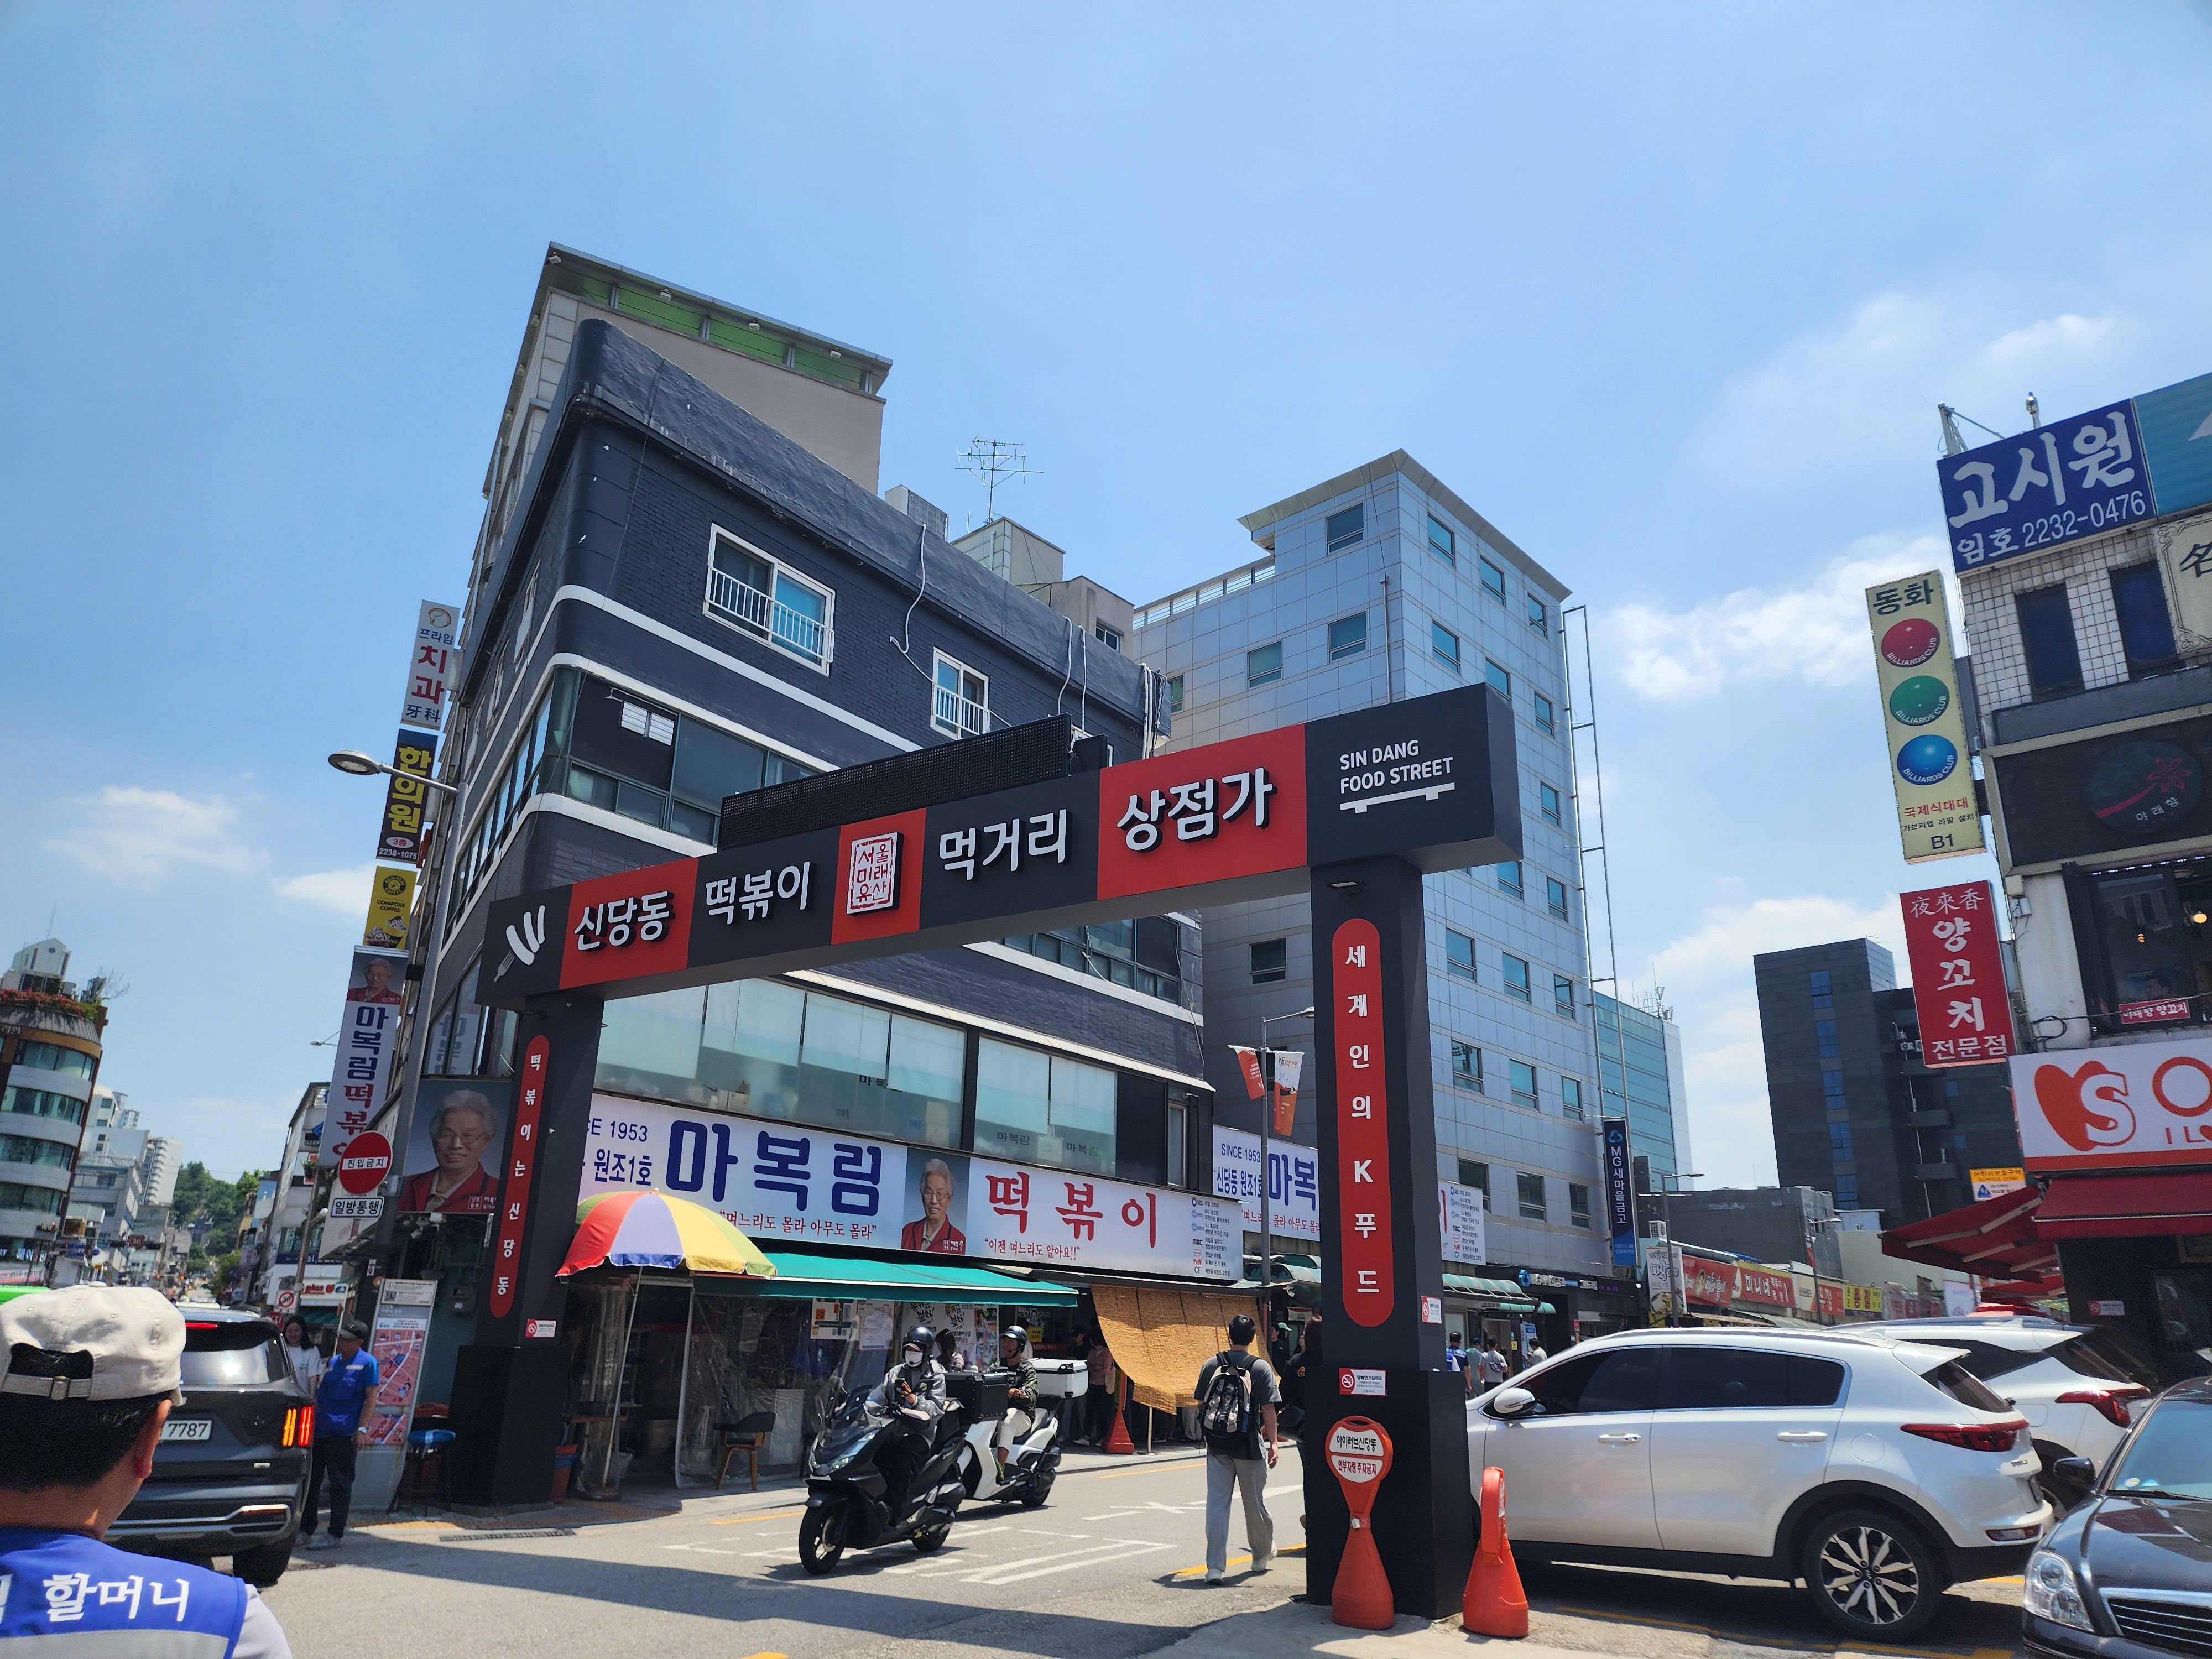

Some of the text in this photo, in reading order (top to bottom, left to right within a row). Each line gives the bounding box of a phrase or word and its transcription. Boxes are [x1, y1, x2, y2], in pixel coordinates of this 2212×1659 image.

[1949, 411, 2135, 528] 고시원
[2022, 490, 2146, 547] 2232-0476
[1873, 579, 1935, 615] 동화
[419, 628, 453, 645] 프라임
[1886, 637, 1937, 666] BILLIARDS CLUB
[411, 645, 447, 705] 치과
[405, 704, 441, 723] 牙科
[1896, 695, 1947, 724] BILLIARDS CLUB
[1339, 739, 1420, 770] SIN DANG
[1903, 754, 1954, 783] BILLIARDS CLUB
[1340, 756, 1454, 794] FOOD STREET
[388, 746, 432, 834] 한의원
[1904, 797, 1969, 818] 국제식대대
[1958, 813, 1974, 822] 설치
[378, 847, 418, 860] 2238-1075
[858, 843, 889, 864] 서울
[1931, 833, 1954, 849] B1
[574, 766, 1274, 951] 신당동 떡볶이 먹거리 상점가
[857, 865, 888, 883] 미래
[855, 883, 887, 902] 유산
[1910, 888, 1984, 918] 夜來香
[1933, 918, 1985, 1032] 양꼬치
[347, 1005, 389, 1081] 마복림
[1932, 1034, 2007, 1061] 전문점
[610, 1120, 648, 1142] 1953
[1345, 944, 1380, 1294] 세계인의 K푸드
[997, 1131, 1030, 1146] 마복림
[1066, 1142, 1099, 1157] 마복림
[347, 1158, 385, 1168] 진입금지
[1221, 1143, 1261, 1163] SINCE 1953
[497, 1053, 541, 1296] 떡볶이는 신당동
[593, 1149, 653, 1187] 원조1호
[665, 1119, 882, 1217] 마복림
[1217, 1166, 1238, 1196] 신당동
[1611, 1146, 1627, 1224] MG새마을금고
[335, 1201, 380, 1215] 일방통행
[985, 1171, 1156, 1249] 떡볶이
[781, 1217, 806, 1235] 몰라
[811, 1221, 846, 1237] 아무도
[1273, 1214, 1287, 1229] 몰라
[1288, 1216, 1307, 1231] 아무도
[1010, 1240, 1044, 1257] 며느리도
[1194, 1266, 1201, 1274] CF
[168, 1422, 208, 1437] 7787
[1336, 1435, 1377, 1452] 아이러브신당동
[44, 1572, 190, 1623] 할머니
